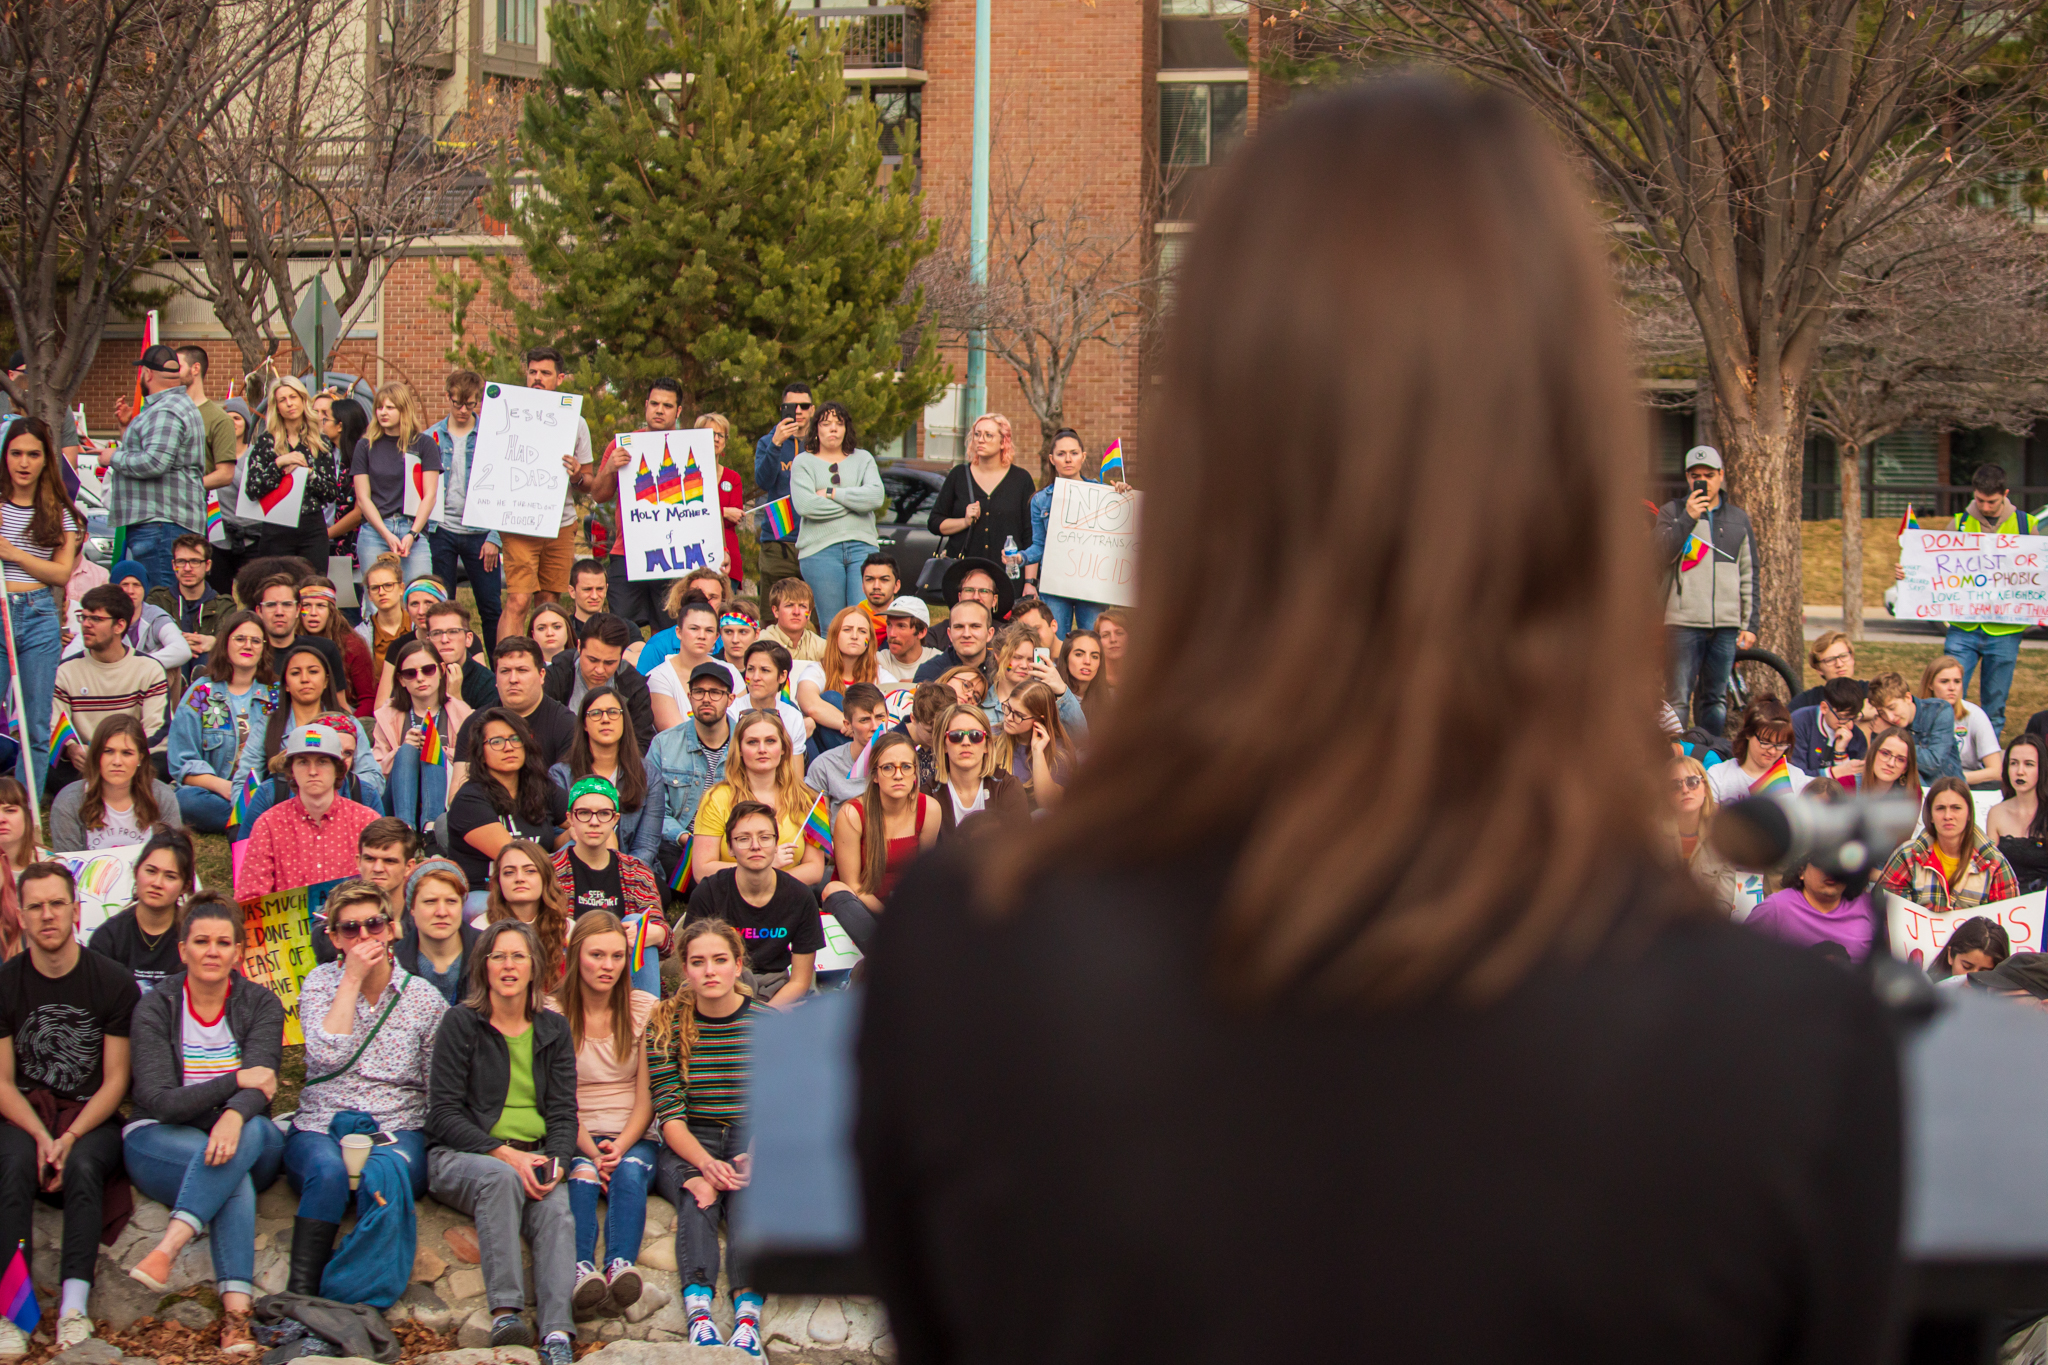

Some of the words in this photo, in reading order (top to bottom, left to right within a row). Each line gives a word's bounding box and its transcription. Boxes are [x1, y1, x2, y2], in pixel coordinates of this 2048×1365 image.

[496, 399, 557, 435] JESUS
[505, 434, 539, 464] HAD
[473, 464, 494, 490] 2
[510, 467, 558, 491] DADS
[497, 499, 506, 507] HE
[513, 500, 543, 510] TURNED
[1065, 484, 1130, 531] NO
[502, 511, 544, 530] FINE!
[630, 508, 660, 522] HOLY
[666, 507, 710, 522] MOTHER
[665, 529, 674, 544] of
[1921, 533, 1985, 549] DON'T
[1996, 534, 2020, 549] BE
[1935, 553, 2006, 574] RACIST
[2014, 553, 2038, 568] OR
[1931, 572, 2041, 591] HOMO-PHOBIC
[1931, 591, 1960, 603] LOVE
[1967, 590, 1992, 600] THY
[1998, 590, 2047, 601] NEIGHBOR
[1916, 603, 1943, 618] CAST
[1949, 603, 1964, 616] THE
[1969, 603, 1991, 616] BEAM
[1994, 602, 2011, 615] OUT
[107, 827, 114, 836] IT
[118, 827, 144, 844] FROM
[577, 895, 618, 907] DISCOMFORT
[588, 890, 604, 899] SEEK
[253, 922, 292, 946] DONE
[298, 917, 313, 936] IT
[289, 945, 306, 967] OF
